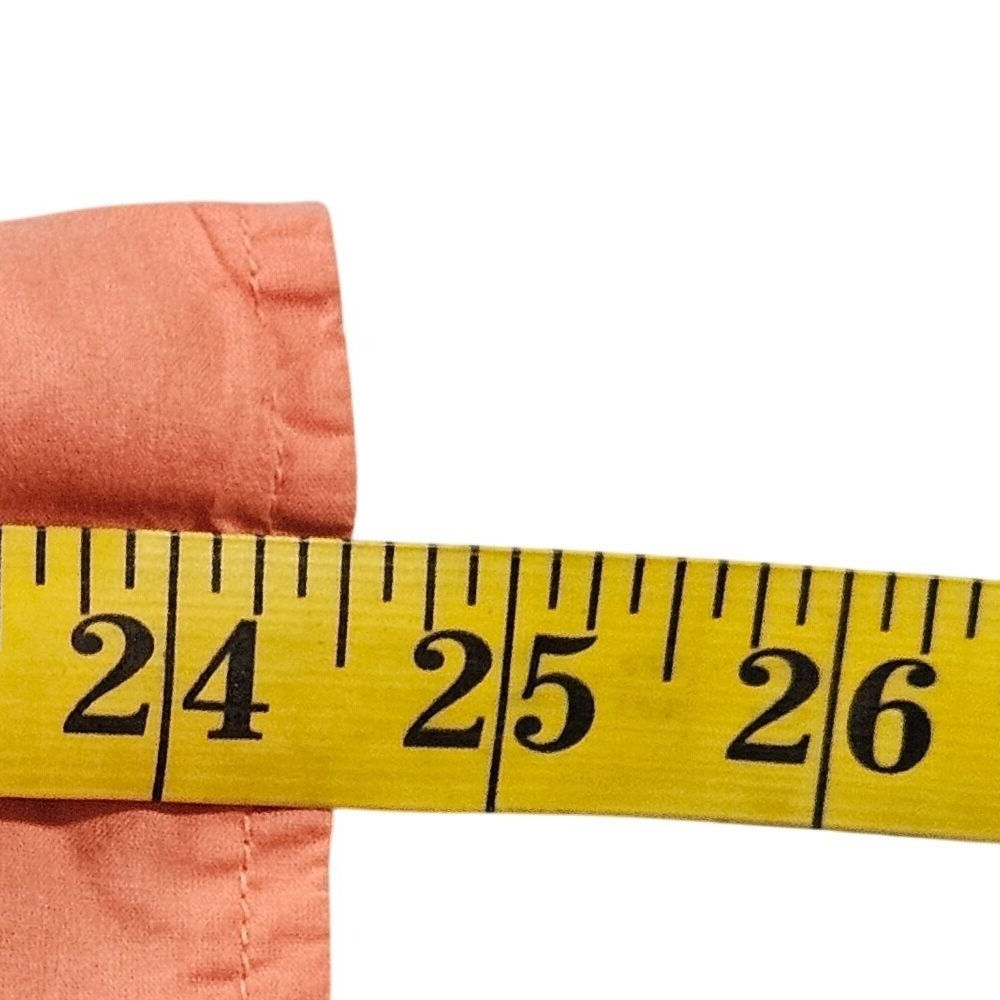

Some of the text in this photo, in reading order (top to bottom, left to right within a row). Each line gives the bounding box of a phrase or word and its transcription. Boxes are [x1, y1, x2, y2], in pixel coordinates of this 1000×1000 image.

[63, 614, 270, 740] 24
[403, 629, 597, 754] 25
[725, 647, 937, 775] 26
